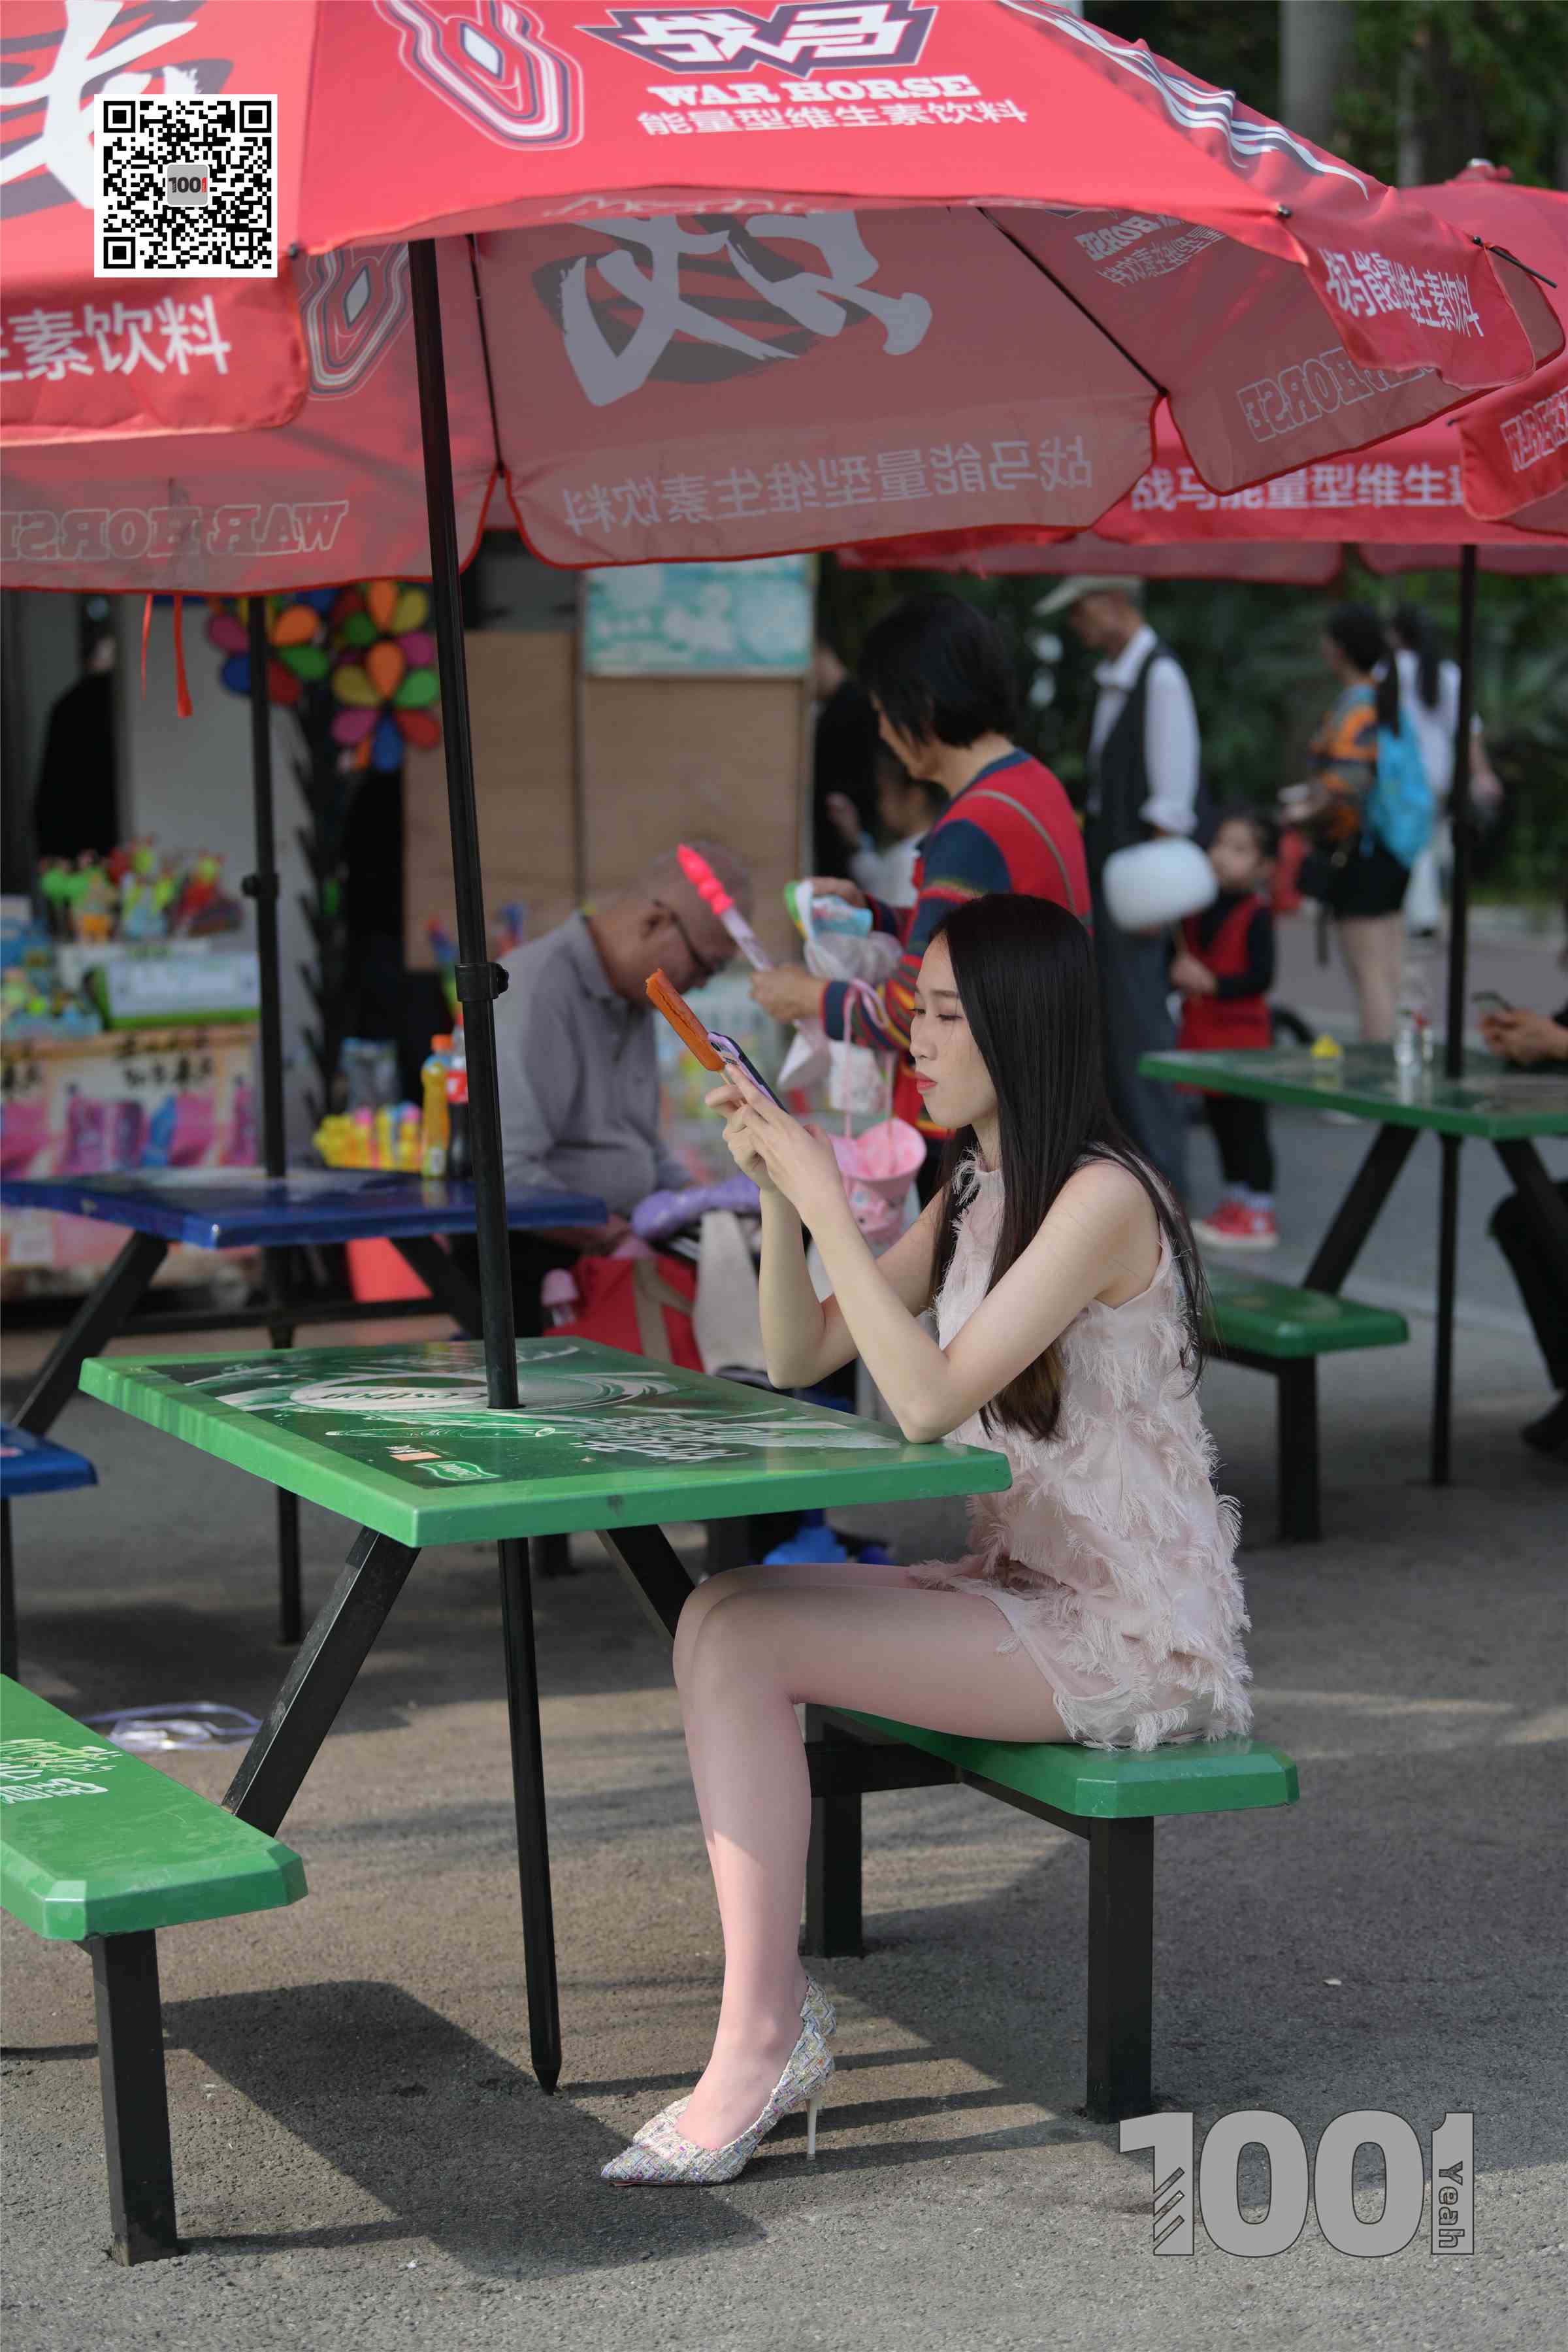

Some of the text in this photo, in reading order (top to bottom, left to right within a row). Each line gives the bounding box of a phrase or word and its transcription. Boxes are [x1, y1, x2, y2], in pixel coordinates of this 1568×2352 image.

[647, 74, 981, 107] WAR HORSE
[637, 98, 1028, 136] 能量型维生素饮料
